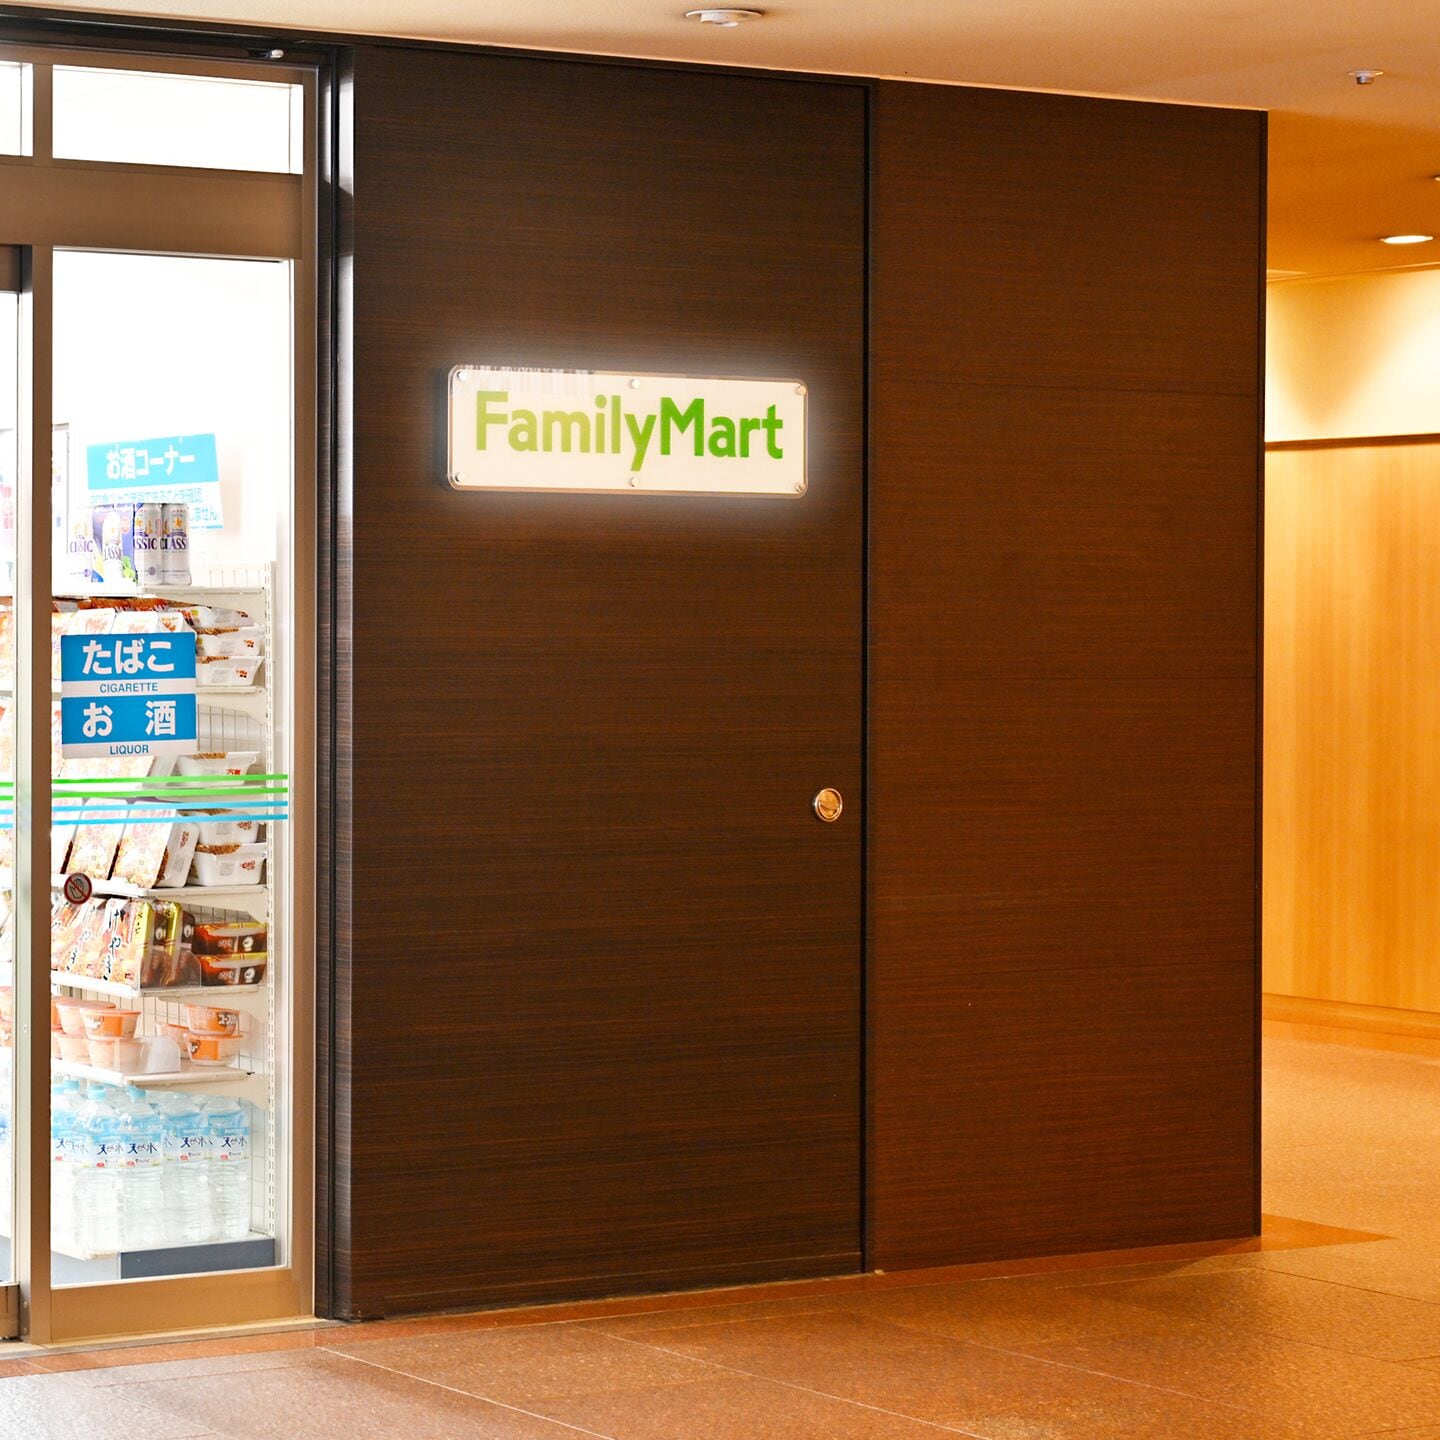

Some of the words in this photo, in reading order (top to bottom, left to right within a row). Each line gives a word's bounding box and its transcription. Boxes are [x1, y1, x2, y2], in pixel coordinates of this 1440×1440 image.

[476, 390, 784, 472] FamilyMart
[105, 443, 196, 480] お酒コーナー
[82, 638, 175, 675] たばこ
[99, 682, 159, 694] CIGARETTE
[82, 700, 177, 738] お酒
[109, 744, 150, 756] LIQUOR
